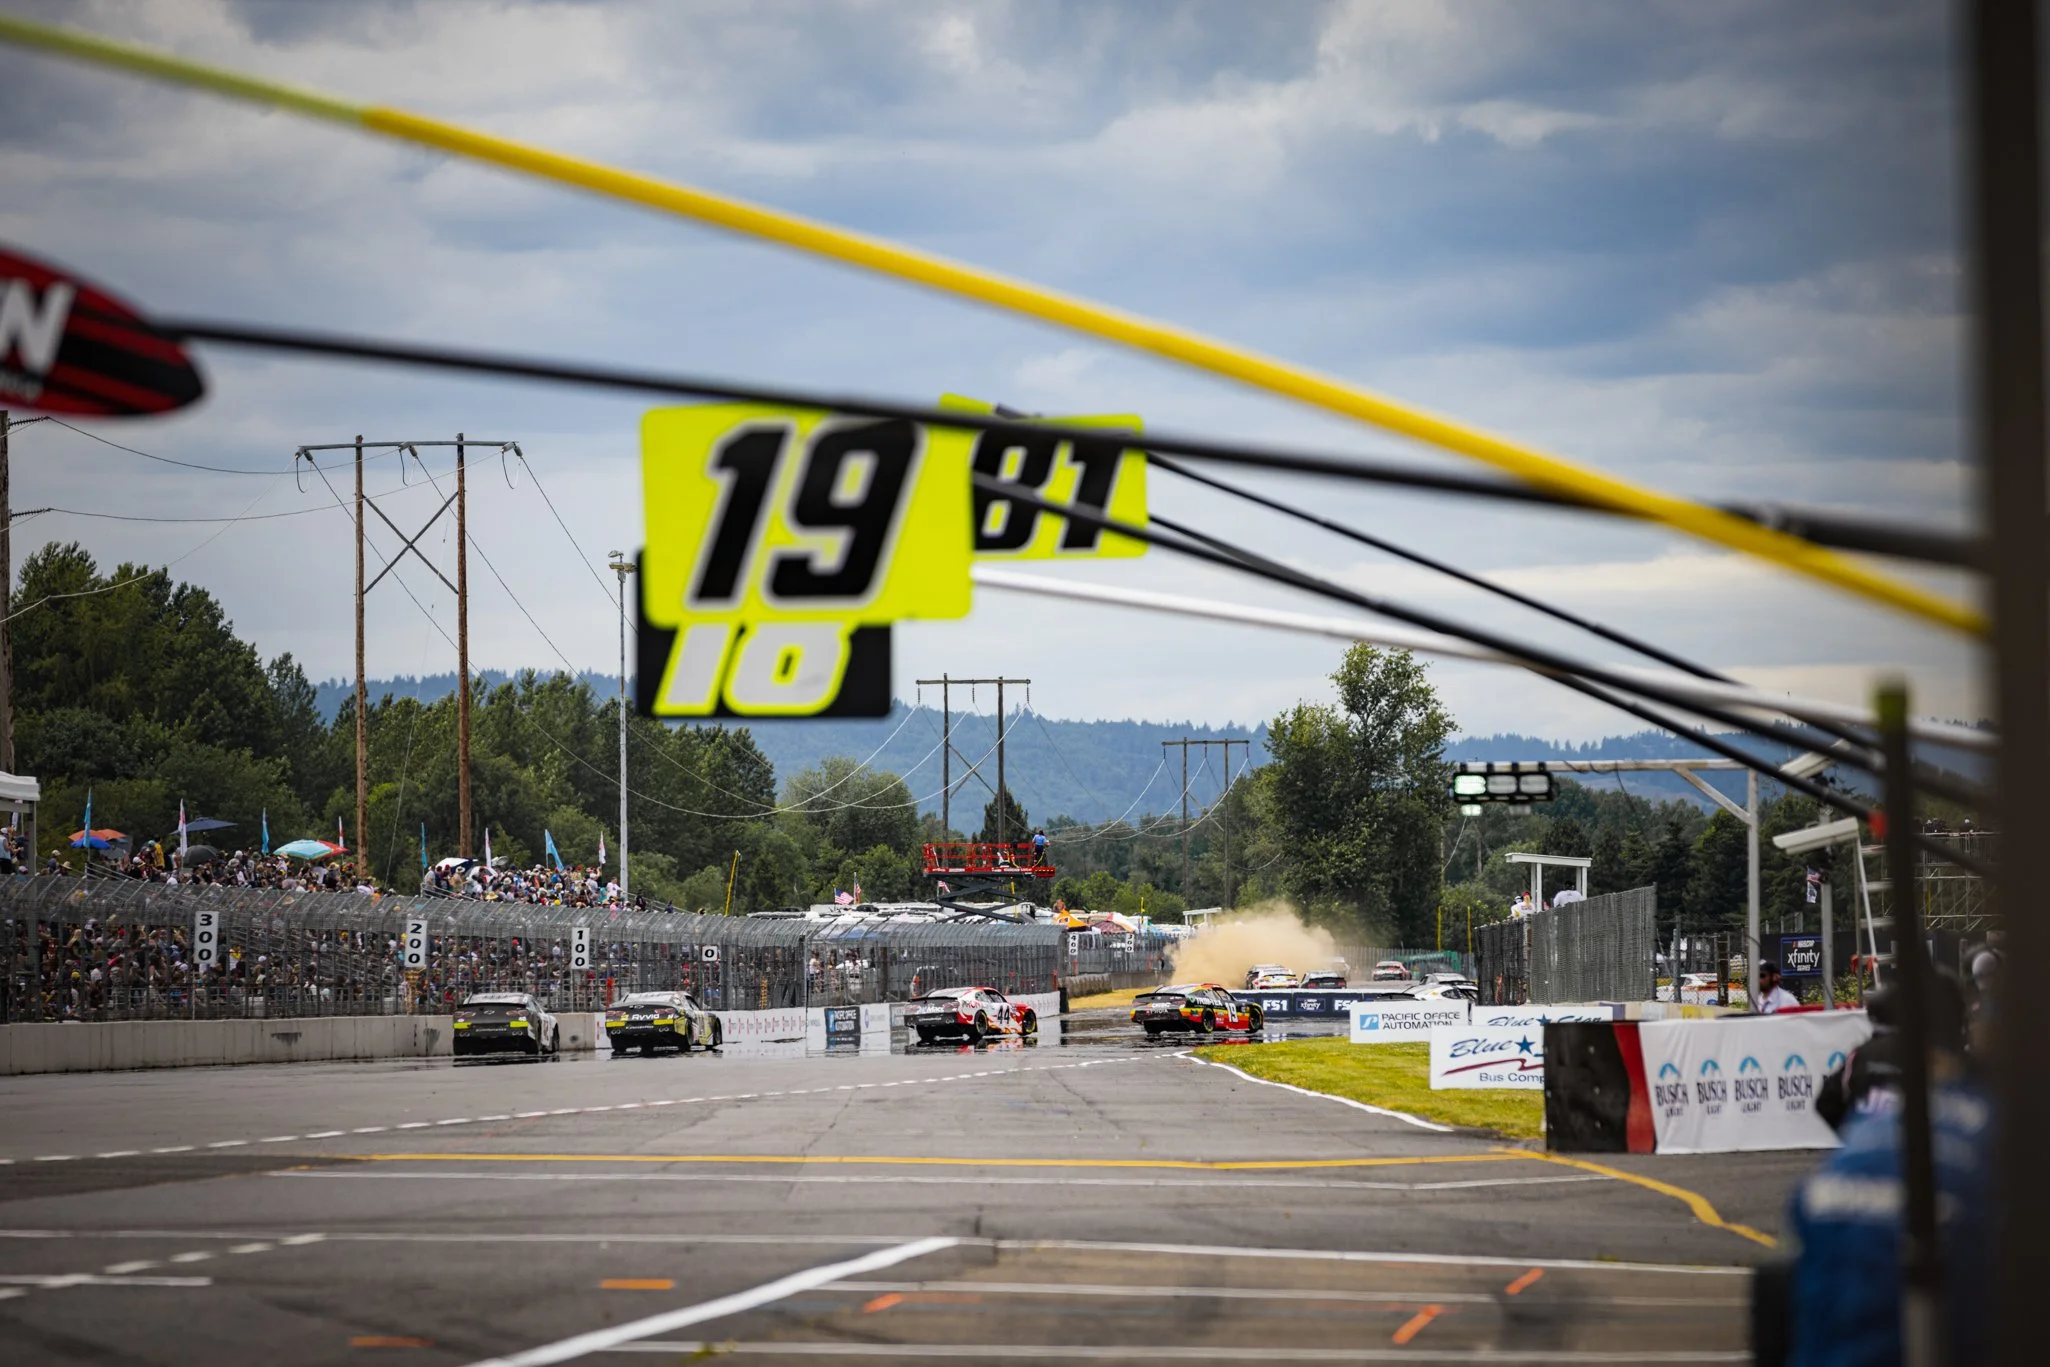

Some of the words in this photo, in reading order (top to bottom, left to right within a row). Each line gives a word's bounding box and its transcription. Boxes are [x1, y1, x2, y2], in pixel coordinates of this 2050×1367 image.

[689, 418, 925, 608] 19
[198, 913, 213, 961] 300
[408, 923, 423, 964] 200
[575, 930, 586, 967] 100
[704, 948, 715, 958] 0
[1787, 949, 1821, 968] xfinity
[998, 1004, 1010, 1025] 44
[1225, 1001, 1239, 1023] 19
[1262, 999, 1288, 1011] FS1
[1381, 1012, 1421, 1021] PACIFIC
[1423, 1011, 1461, 1020] OFFICE
[1382, 1020, 1453, 1030] AUTOMATION
[1449, 1038, 1514, 1059] Blue
[1479, 1072, 1504, 1083] Bus
[1778, 1074, 1813, 1099] BUSCH
[1655, 1083, 1689, 1107] BUSCH
[1697, 1080, 1728, 1105] BUSCH
[1734, 1078, 1768, 1101] BUSCH
